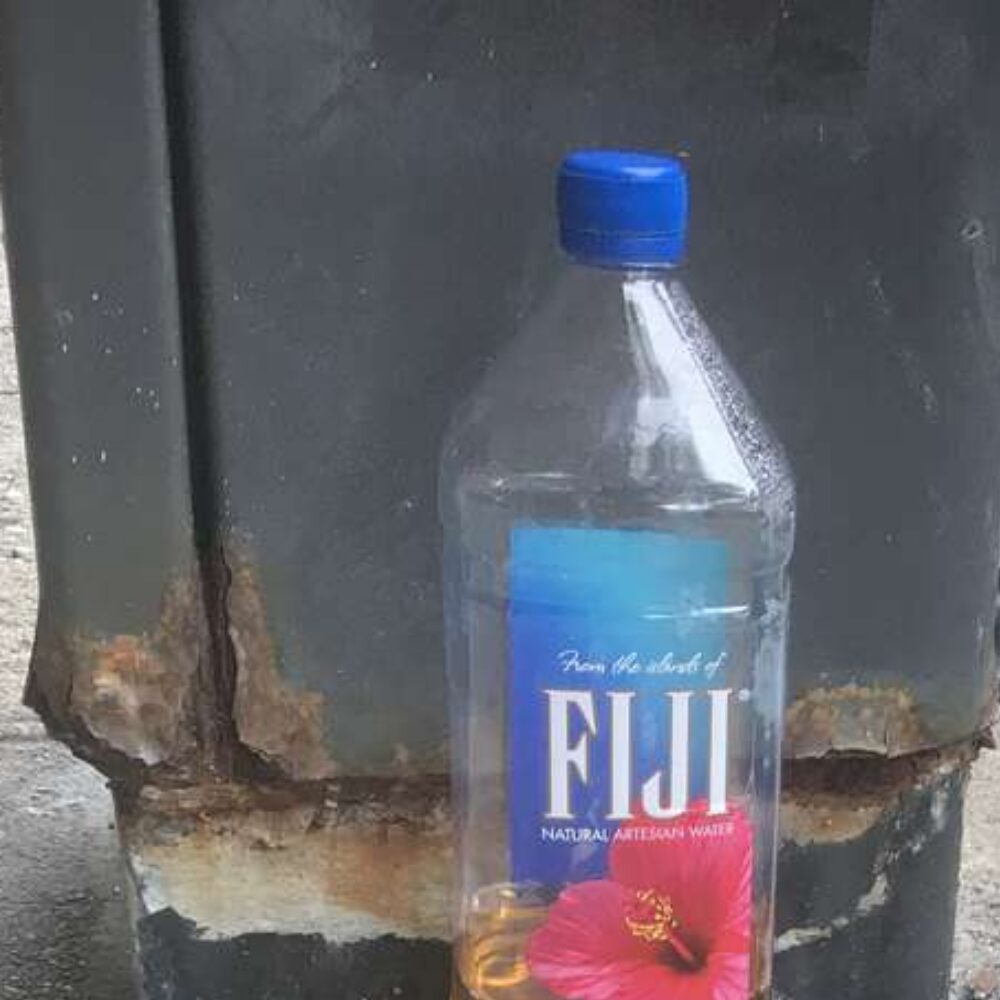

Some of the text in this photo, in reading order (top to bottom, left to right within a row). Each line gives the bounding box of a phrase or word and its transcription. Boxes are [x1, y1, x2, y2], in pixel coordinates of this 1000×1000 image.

[557, 650, 605, 673] From
[611, 651, 641, 679] the
[704, 652, 727, 679] of
[544, 688, 733, 820] FIJI
[541, 822, 735, 842] NATURAL ARTESIAN WATER
